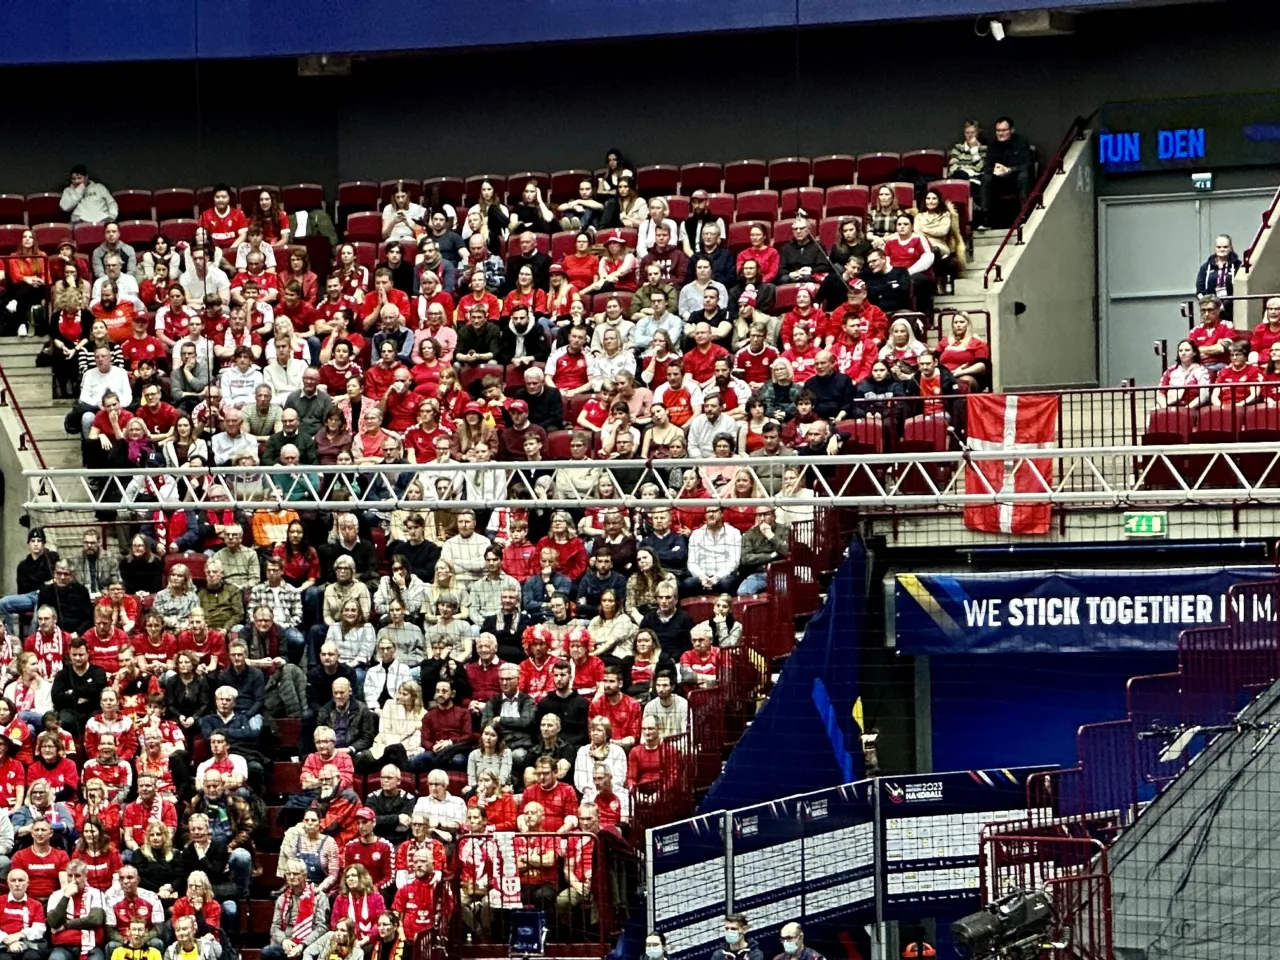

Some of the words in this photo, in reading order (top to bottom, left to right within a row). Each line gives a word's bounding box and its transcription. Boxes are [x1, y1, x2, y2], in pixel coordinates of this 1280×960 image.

[1157, 128, 1206, 160] DEN
[964, 599, 1002, 627] WE
[1008, 597, 1080, 626] STICK
[1086, 594, 1213, 625] TOGETHER
[922, 782, 943, 791] 2023
